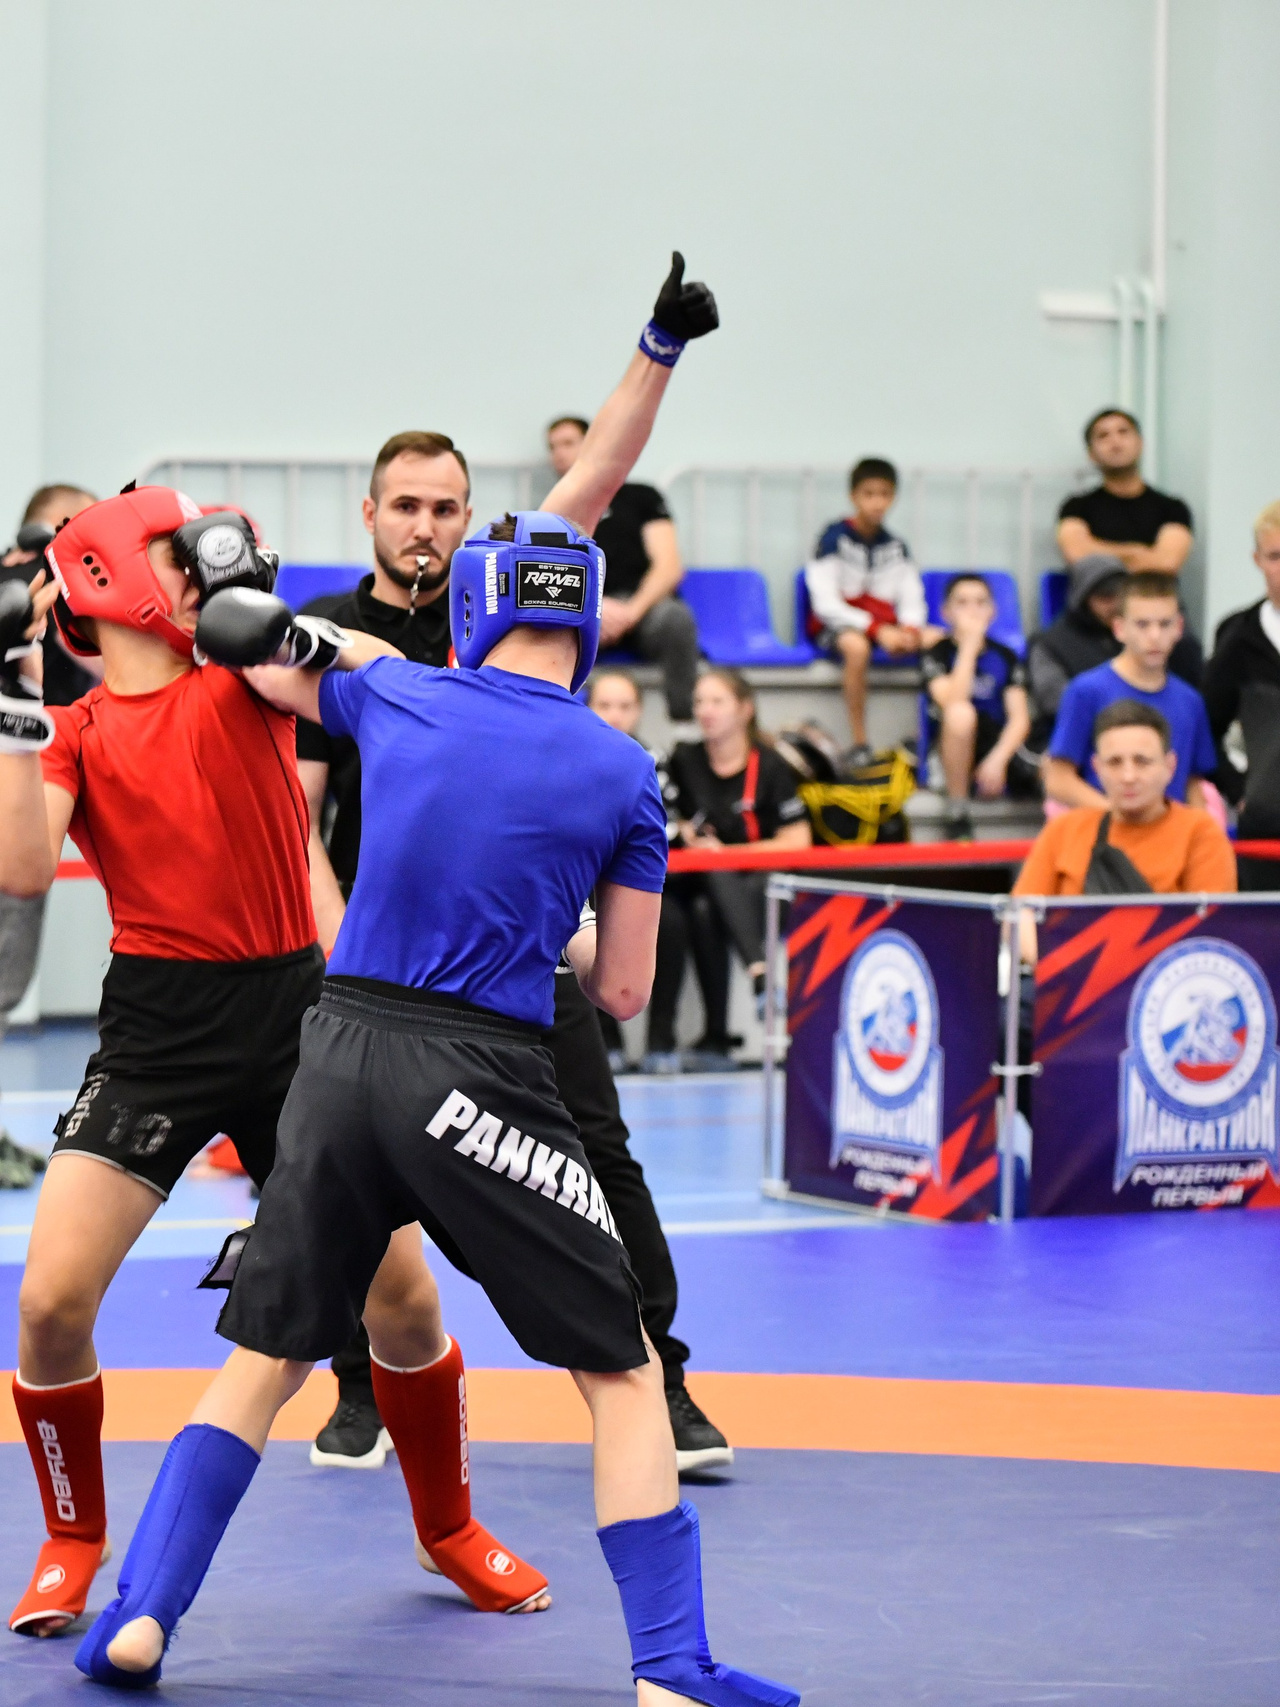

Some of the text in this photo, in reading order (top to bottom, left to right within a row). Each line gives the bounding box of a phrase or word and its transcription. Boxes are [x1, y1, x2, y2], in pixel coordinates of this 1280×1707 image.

[485, 552, 498, 615] PANKRATION
[548, 600, 578, 608] EQUIPMENT
[1125, 1063, 1276, 1157] ПАНКРАТИОН
[1131, 1159, 1267, 1187] РОЖДЕННЫЙ
[37, 1418, 76, 1522] BOYBO
